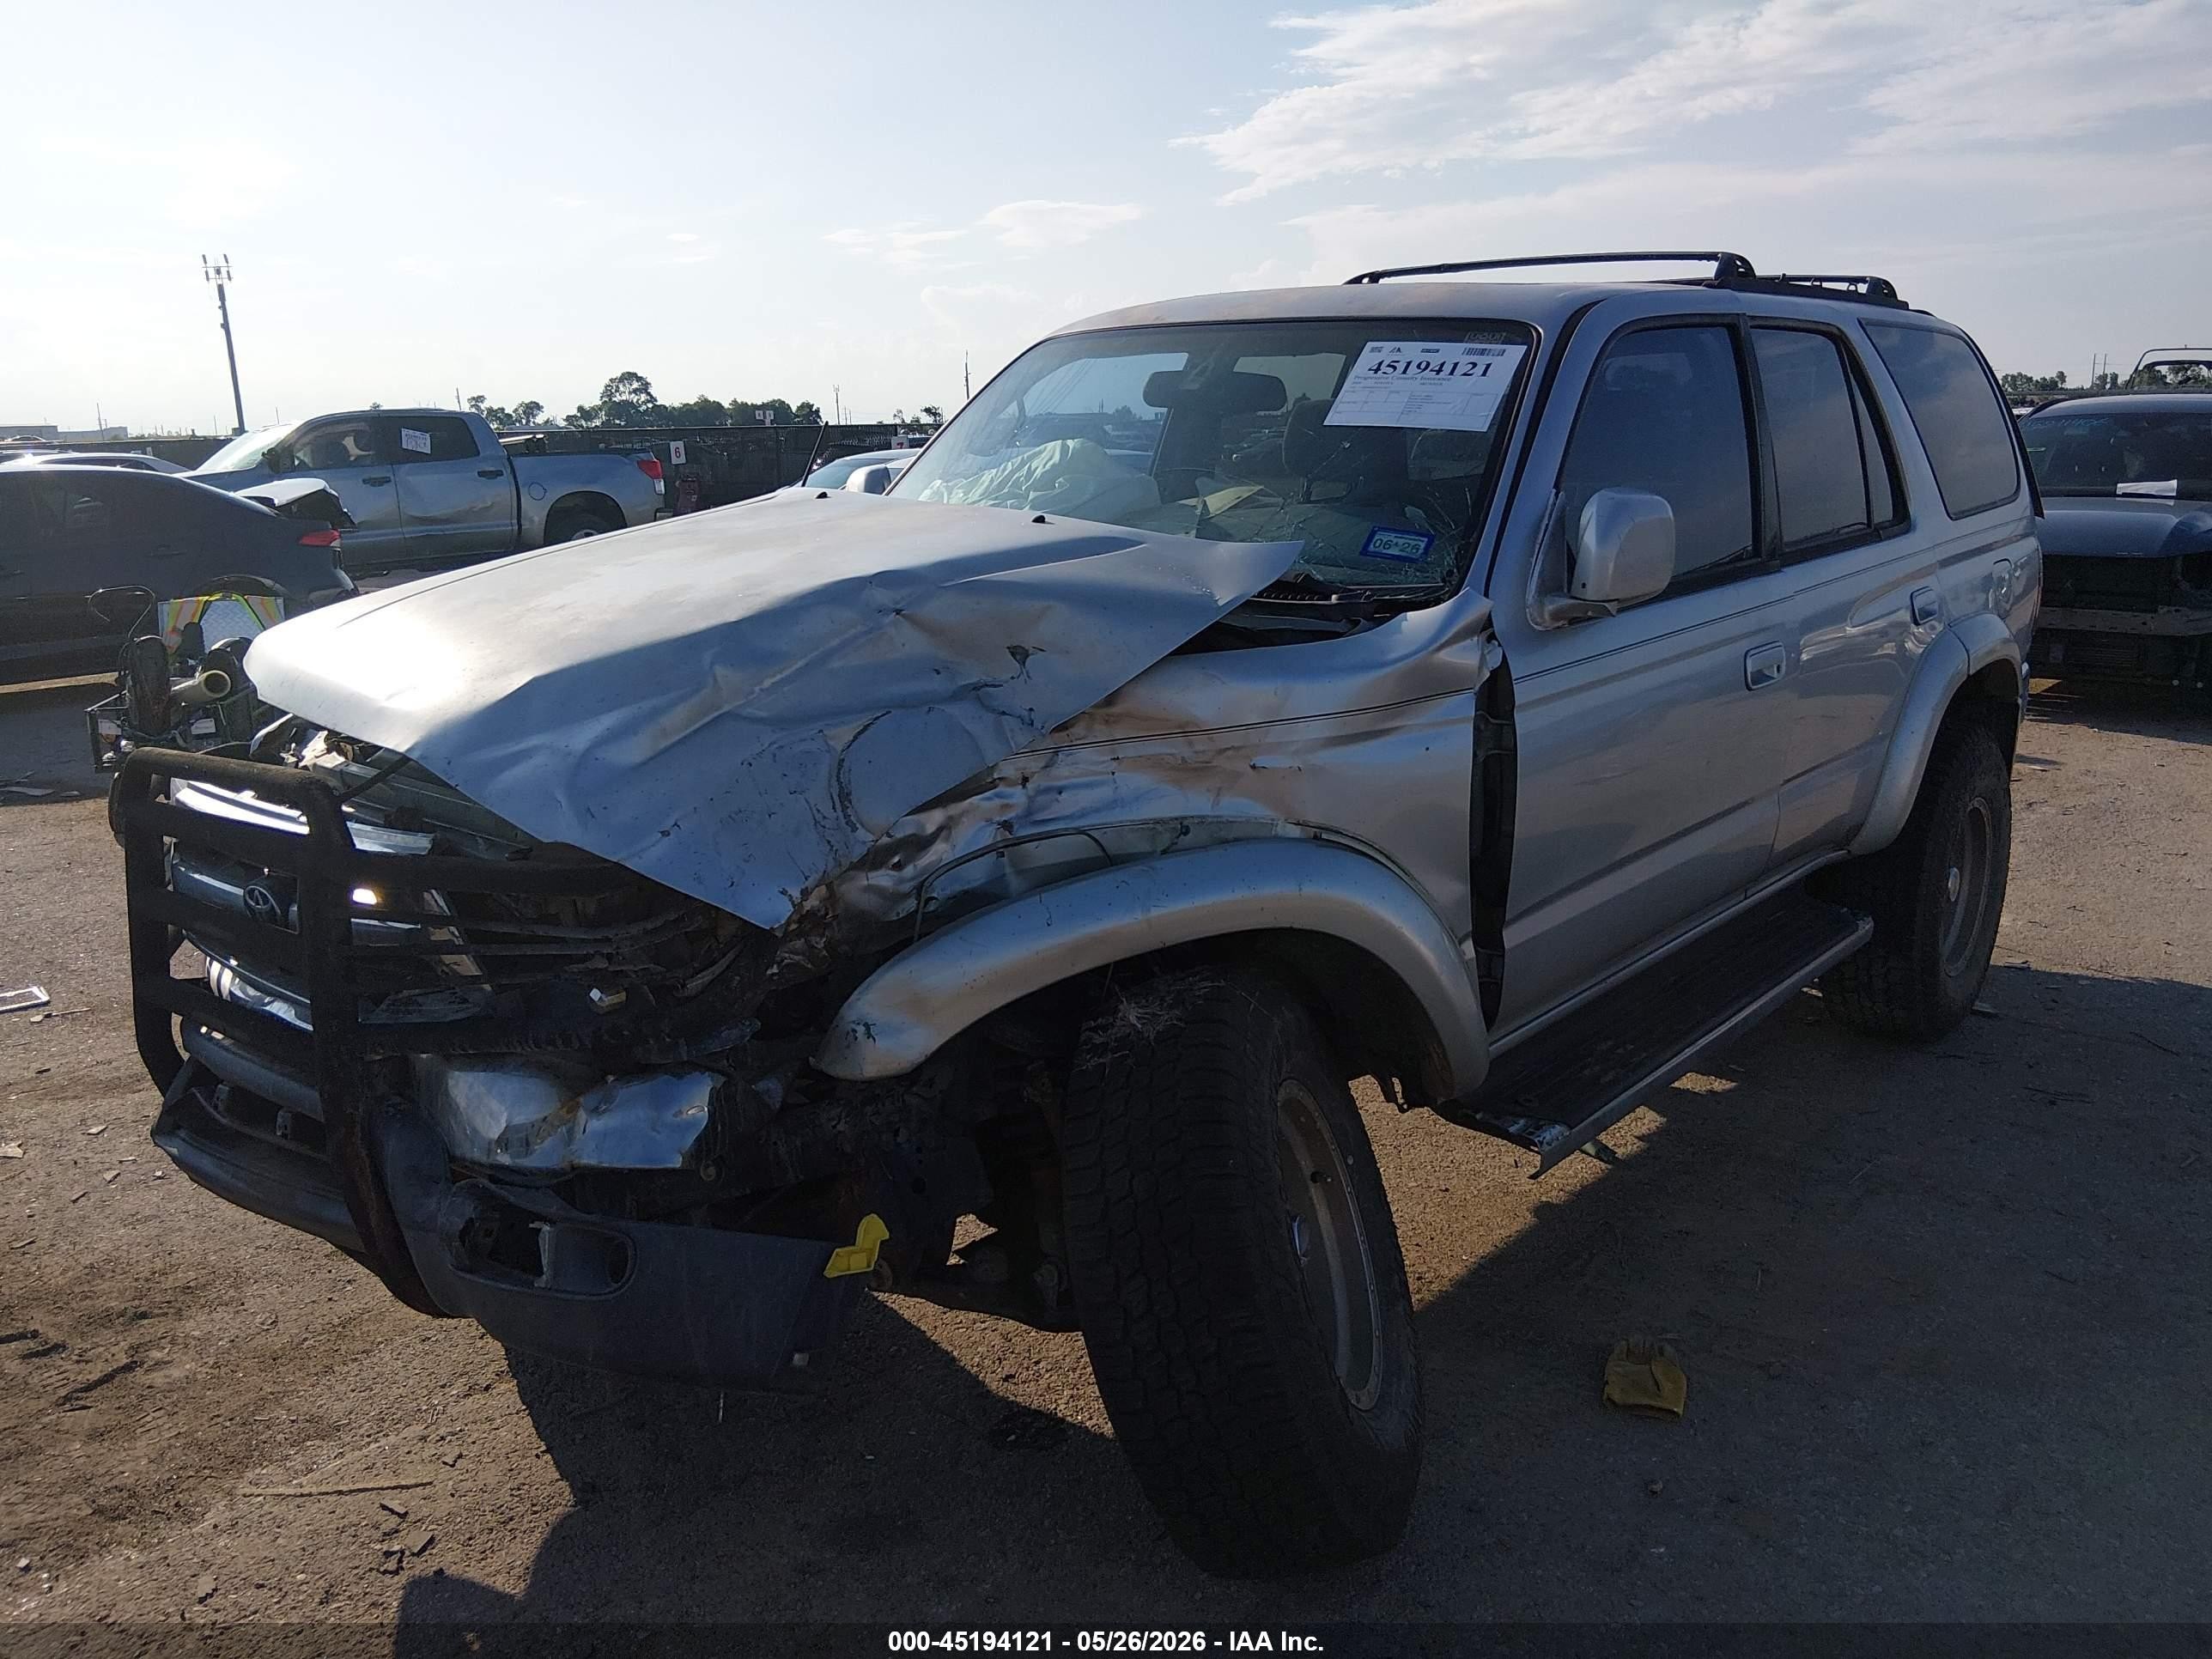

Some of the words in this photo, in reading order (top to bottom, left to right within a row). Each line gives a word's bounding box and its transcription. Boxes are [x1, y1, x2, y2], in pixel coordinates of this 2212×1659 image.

[1368, 360, 1492, 377] 45194121
[674, 447, 681, 459] 6
[1373, 538, 1394, 550] 06
